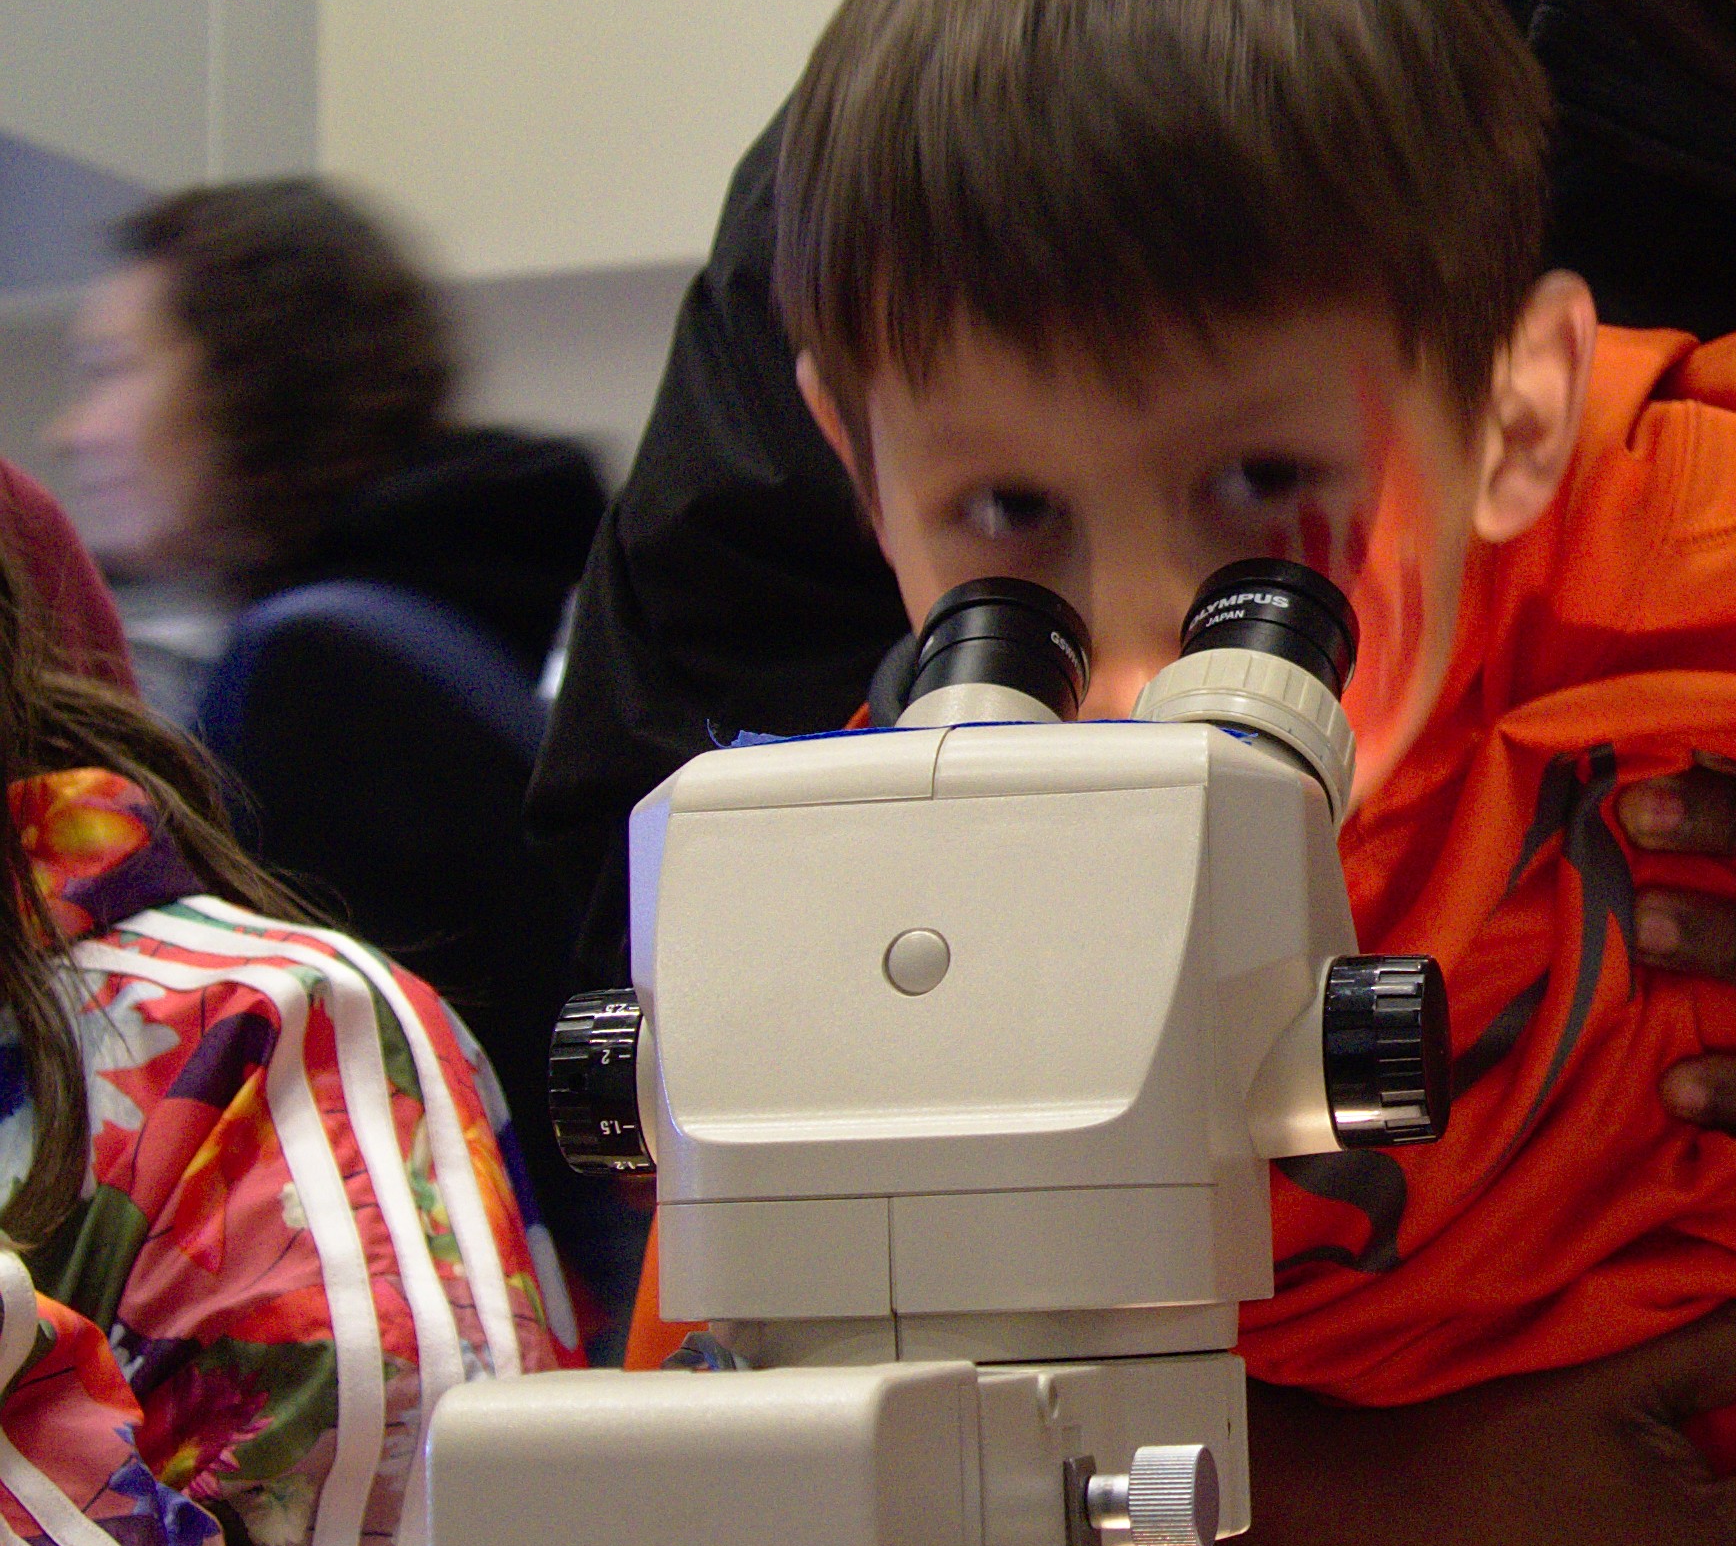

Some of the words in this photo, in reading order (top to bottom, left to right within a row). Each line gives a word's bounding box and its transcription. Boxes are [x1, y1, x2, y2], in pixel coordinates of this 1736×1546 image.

[1188, 592, 1290, 631] OLYMPUS
[1205, 609, 1246, 628] JAPAN
[601, 1048, 611, 1065] 2
[600, 1119, 622, 1136] 1.5
